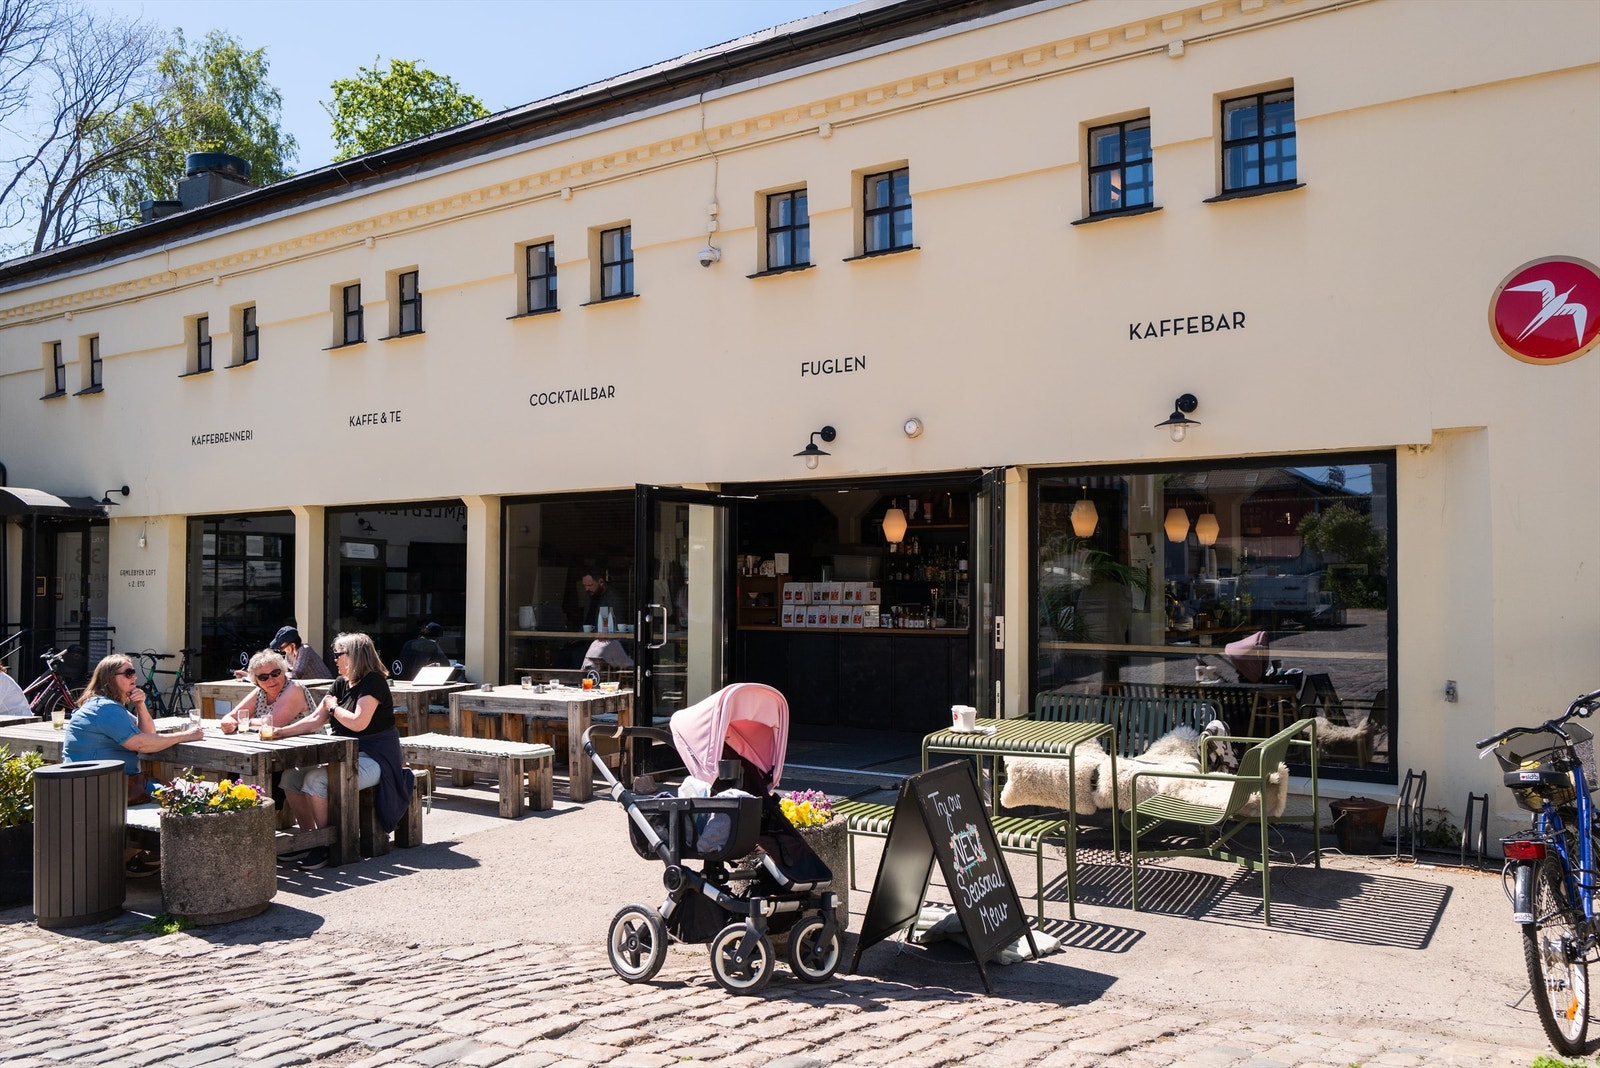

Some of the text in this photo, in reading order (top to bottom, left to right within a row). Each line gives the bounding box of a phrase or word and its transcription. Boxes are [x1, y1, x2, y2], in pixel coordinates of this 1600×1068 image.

[1129, 311, 1246, 341] KAFFEBAR
[801, 355, 866, 377] FUGLEN
[529, 385, 616, 407] COCKTAILBAR
[349, 410, 402, 427] KAFFE & TE
[191, 429, 253, 446] KAFFEBRENNERI
[928, 791, 954, 833] Try
[953, 833, 985, 866] NEW
[957, 858, 1005, 909] Seasonal
[979, 902, 1008, 935] Menu
